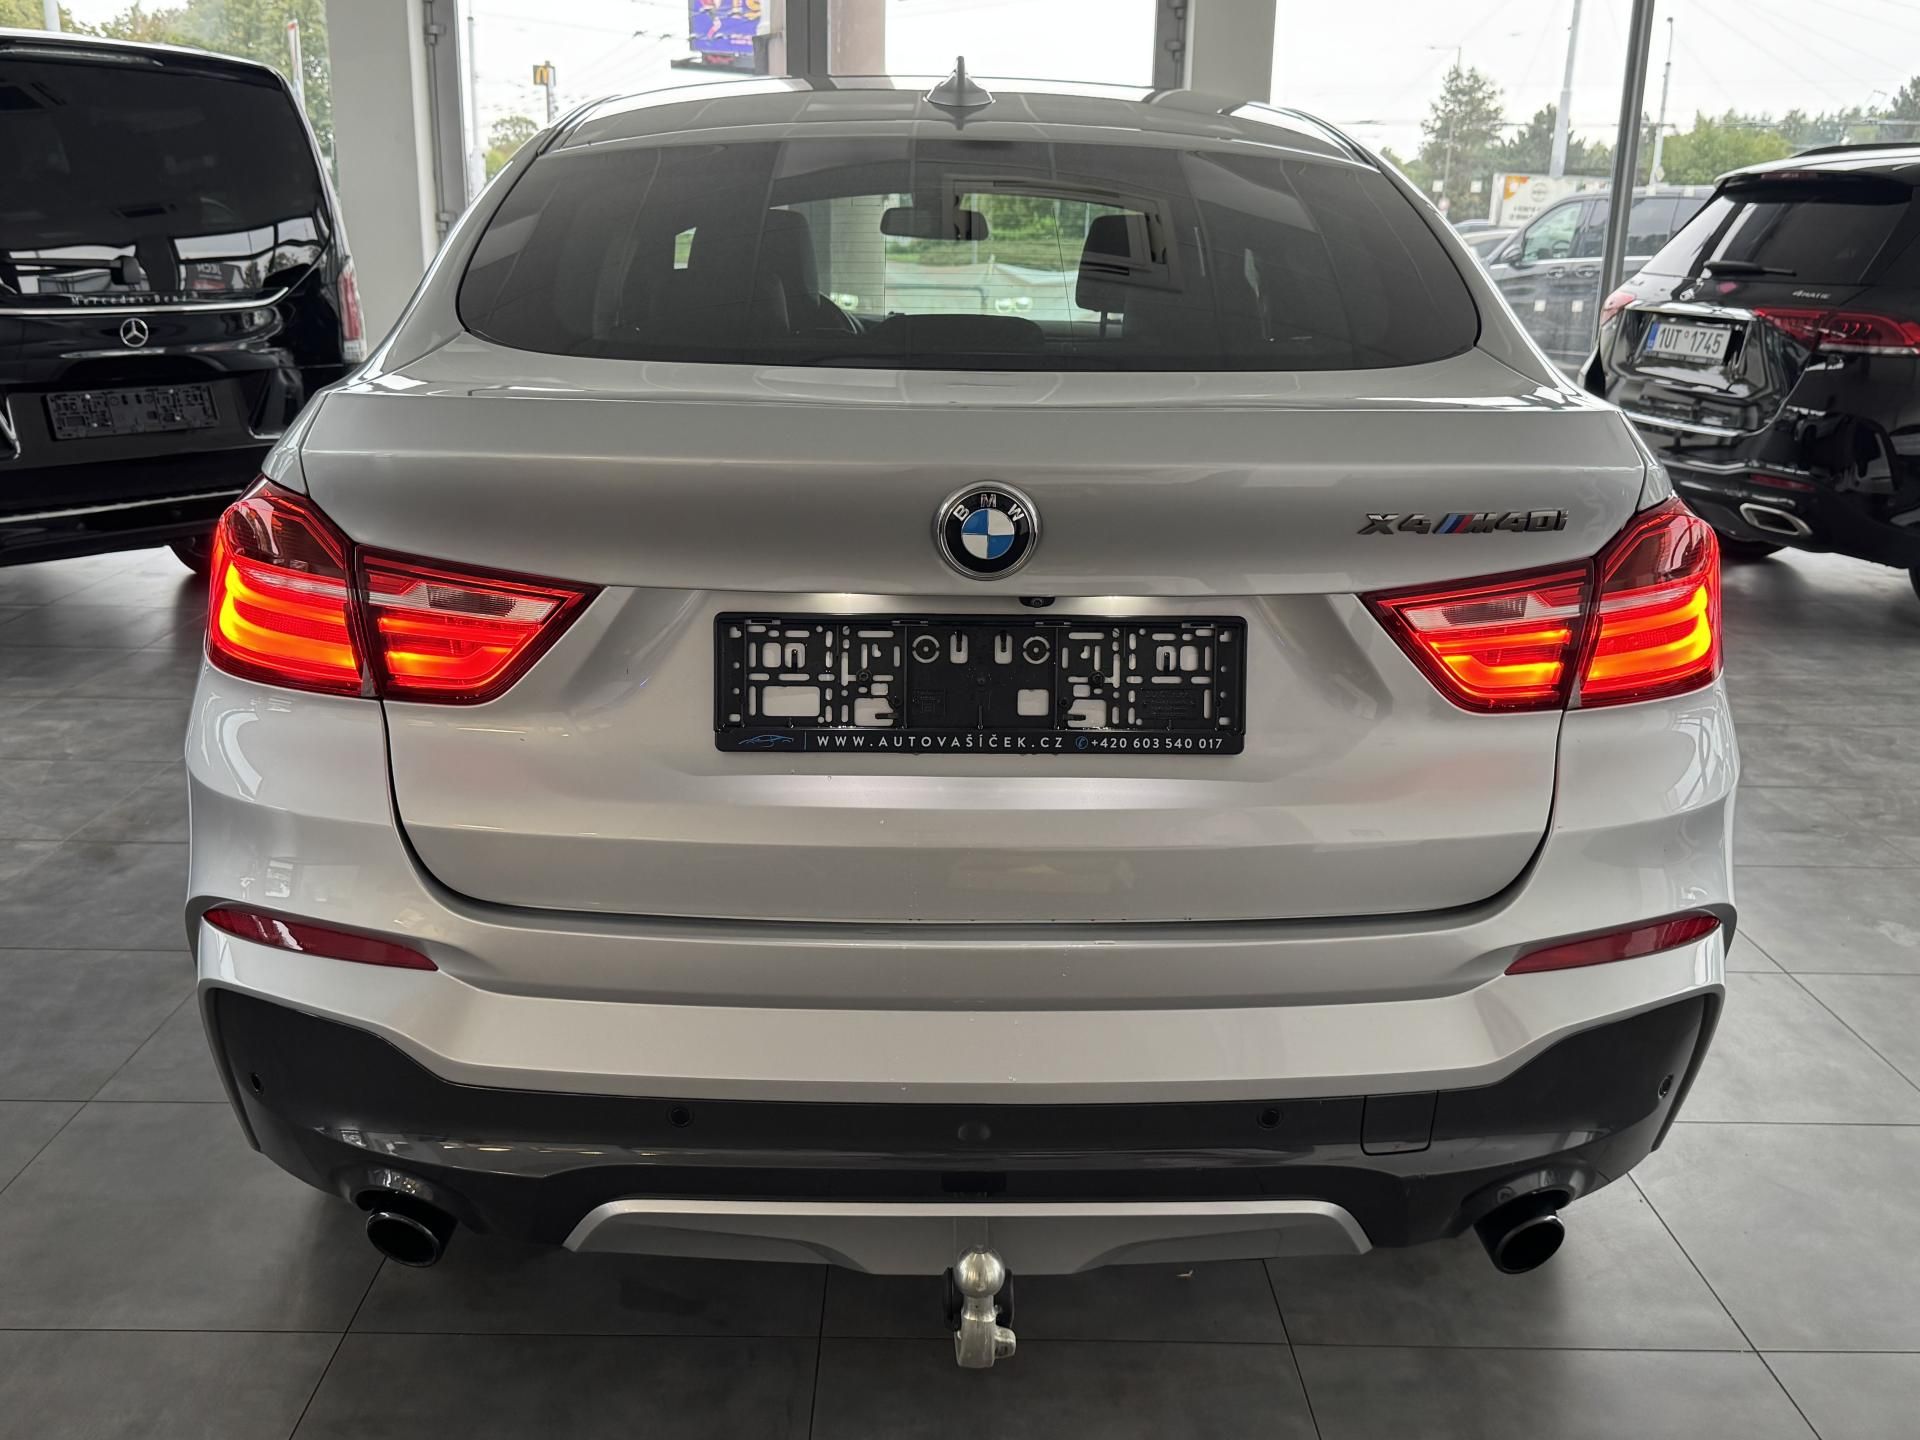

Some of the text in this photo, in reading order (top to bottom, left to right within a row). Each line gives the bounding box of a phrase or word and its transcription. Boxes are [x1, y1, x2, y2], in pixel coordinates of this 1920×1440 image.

[1659, 327, 1724, 354] 1UT 1745
[953, 494, 1025, 522] BMW
[1357, 513, 1432, 535] X4
[817, 734, 1223, 749] WWW.AUTOVAŠÍČEK.CZ +420 603 540 017
